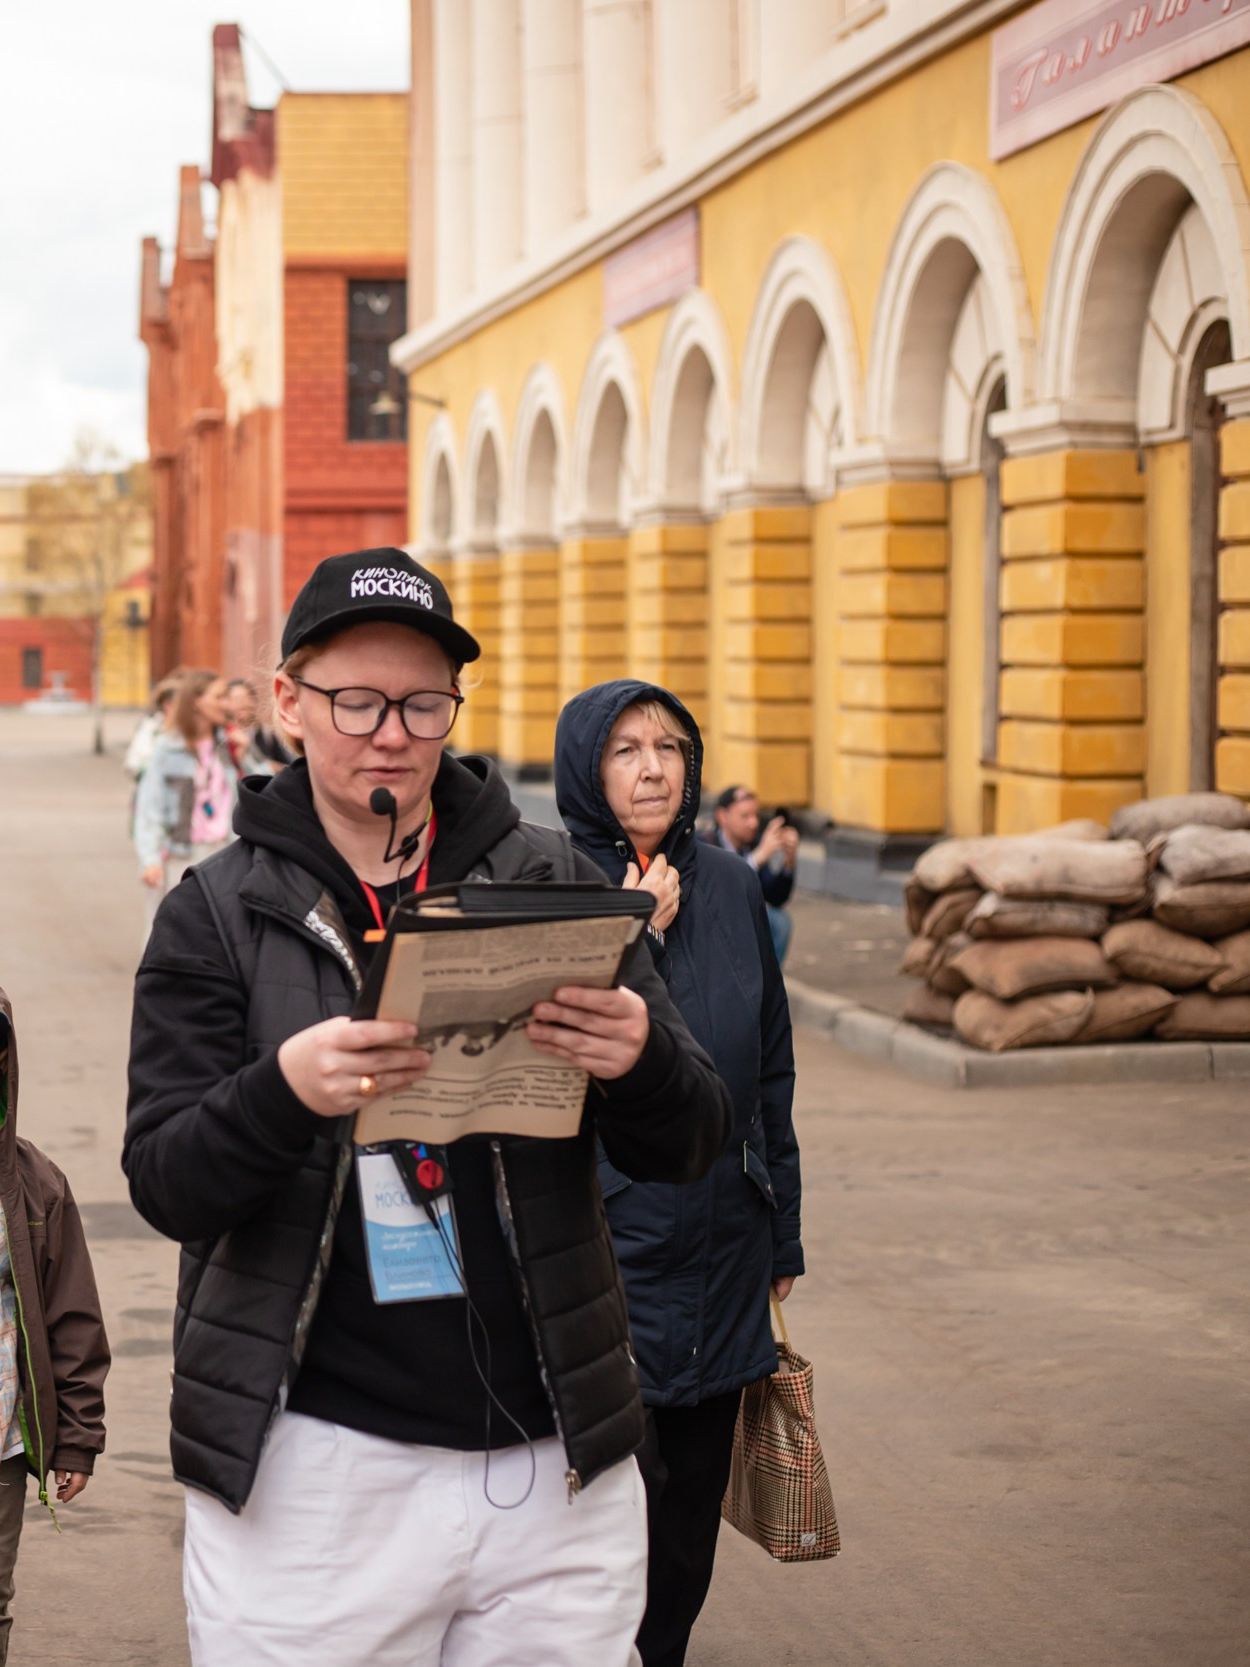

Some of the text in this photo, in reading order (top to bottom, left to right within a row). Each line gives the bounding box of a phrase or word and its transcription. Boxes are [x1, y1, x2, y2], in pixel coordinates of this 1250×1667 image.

[350, 578, 434, 610] МОСКИНО
[351, 567, 433, 594] КИНОПАРК
[374, 1190, 411, 1209] МОСК
